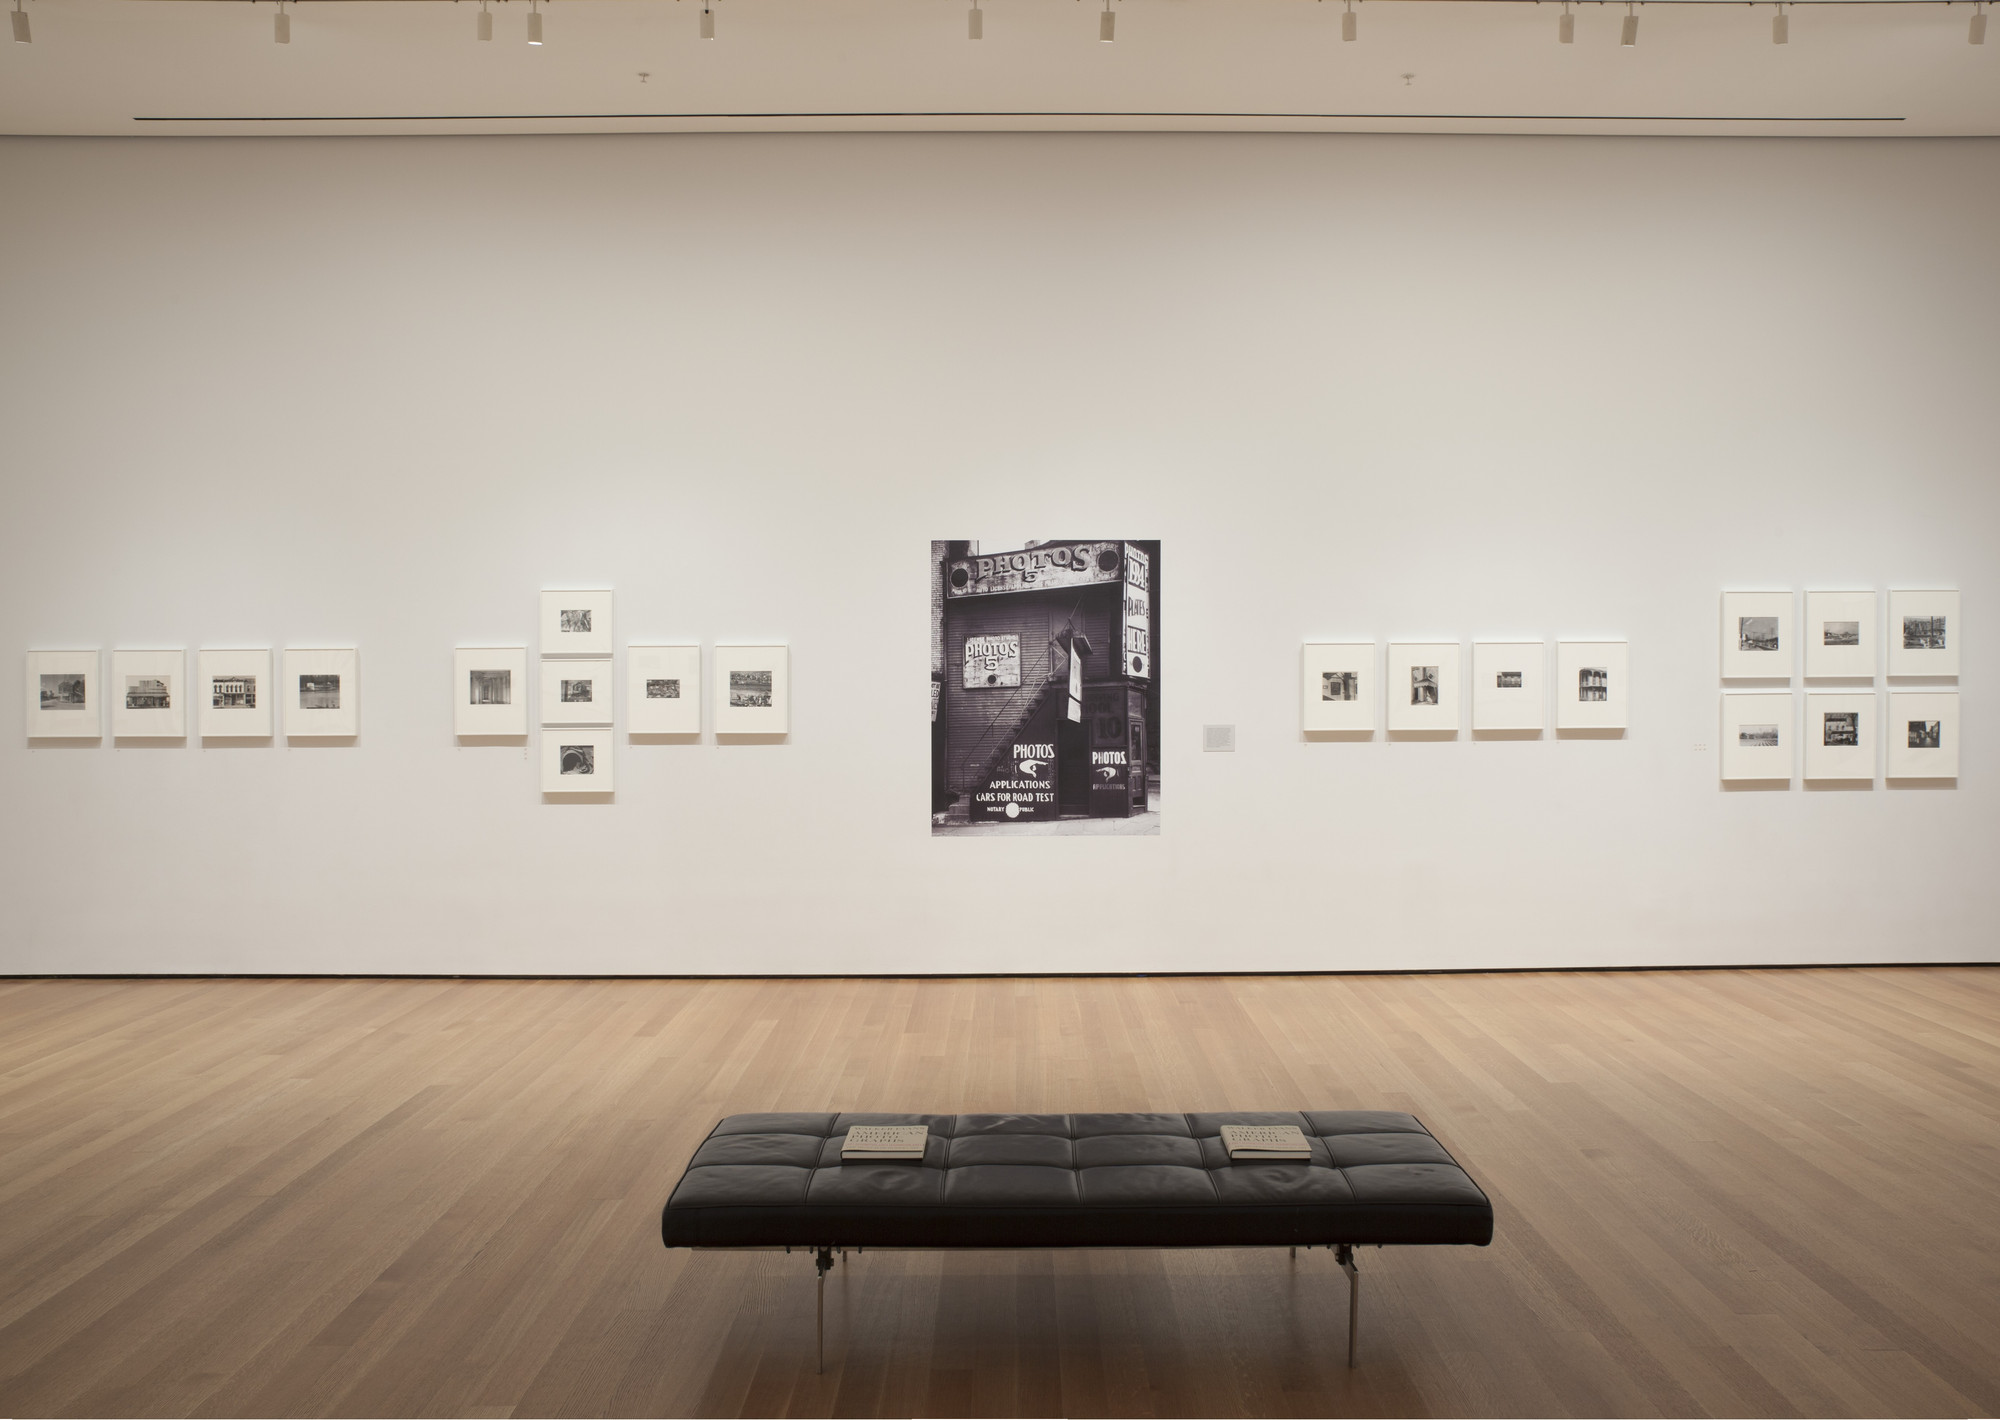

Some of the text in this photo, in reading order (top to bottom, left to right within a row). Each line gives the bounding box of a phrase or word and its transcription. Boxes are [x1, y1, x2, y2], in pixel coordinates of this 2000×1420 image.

[975, 545, 1090, 584] PHOTOS
[1128, 596, 1145, 616] PLATES
[1128, 627, 1146, 652] HERE
[965, 641, 1018, 665] PHOTOS
[984, 656, 999, 670] 5
[1013, 744, 1055, 759] PHOTOS
[1092, 751, 1127, 764] PHOTOS
[989, 780, 1051, 789] APPLICATIONS
[976, 792, 1054, 802] CARS FOR ROAD TEST
